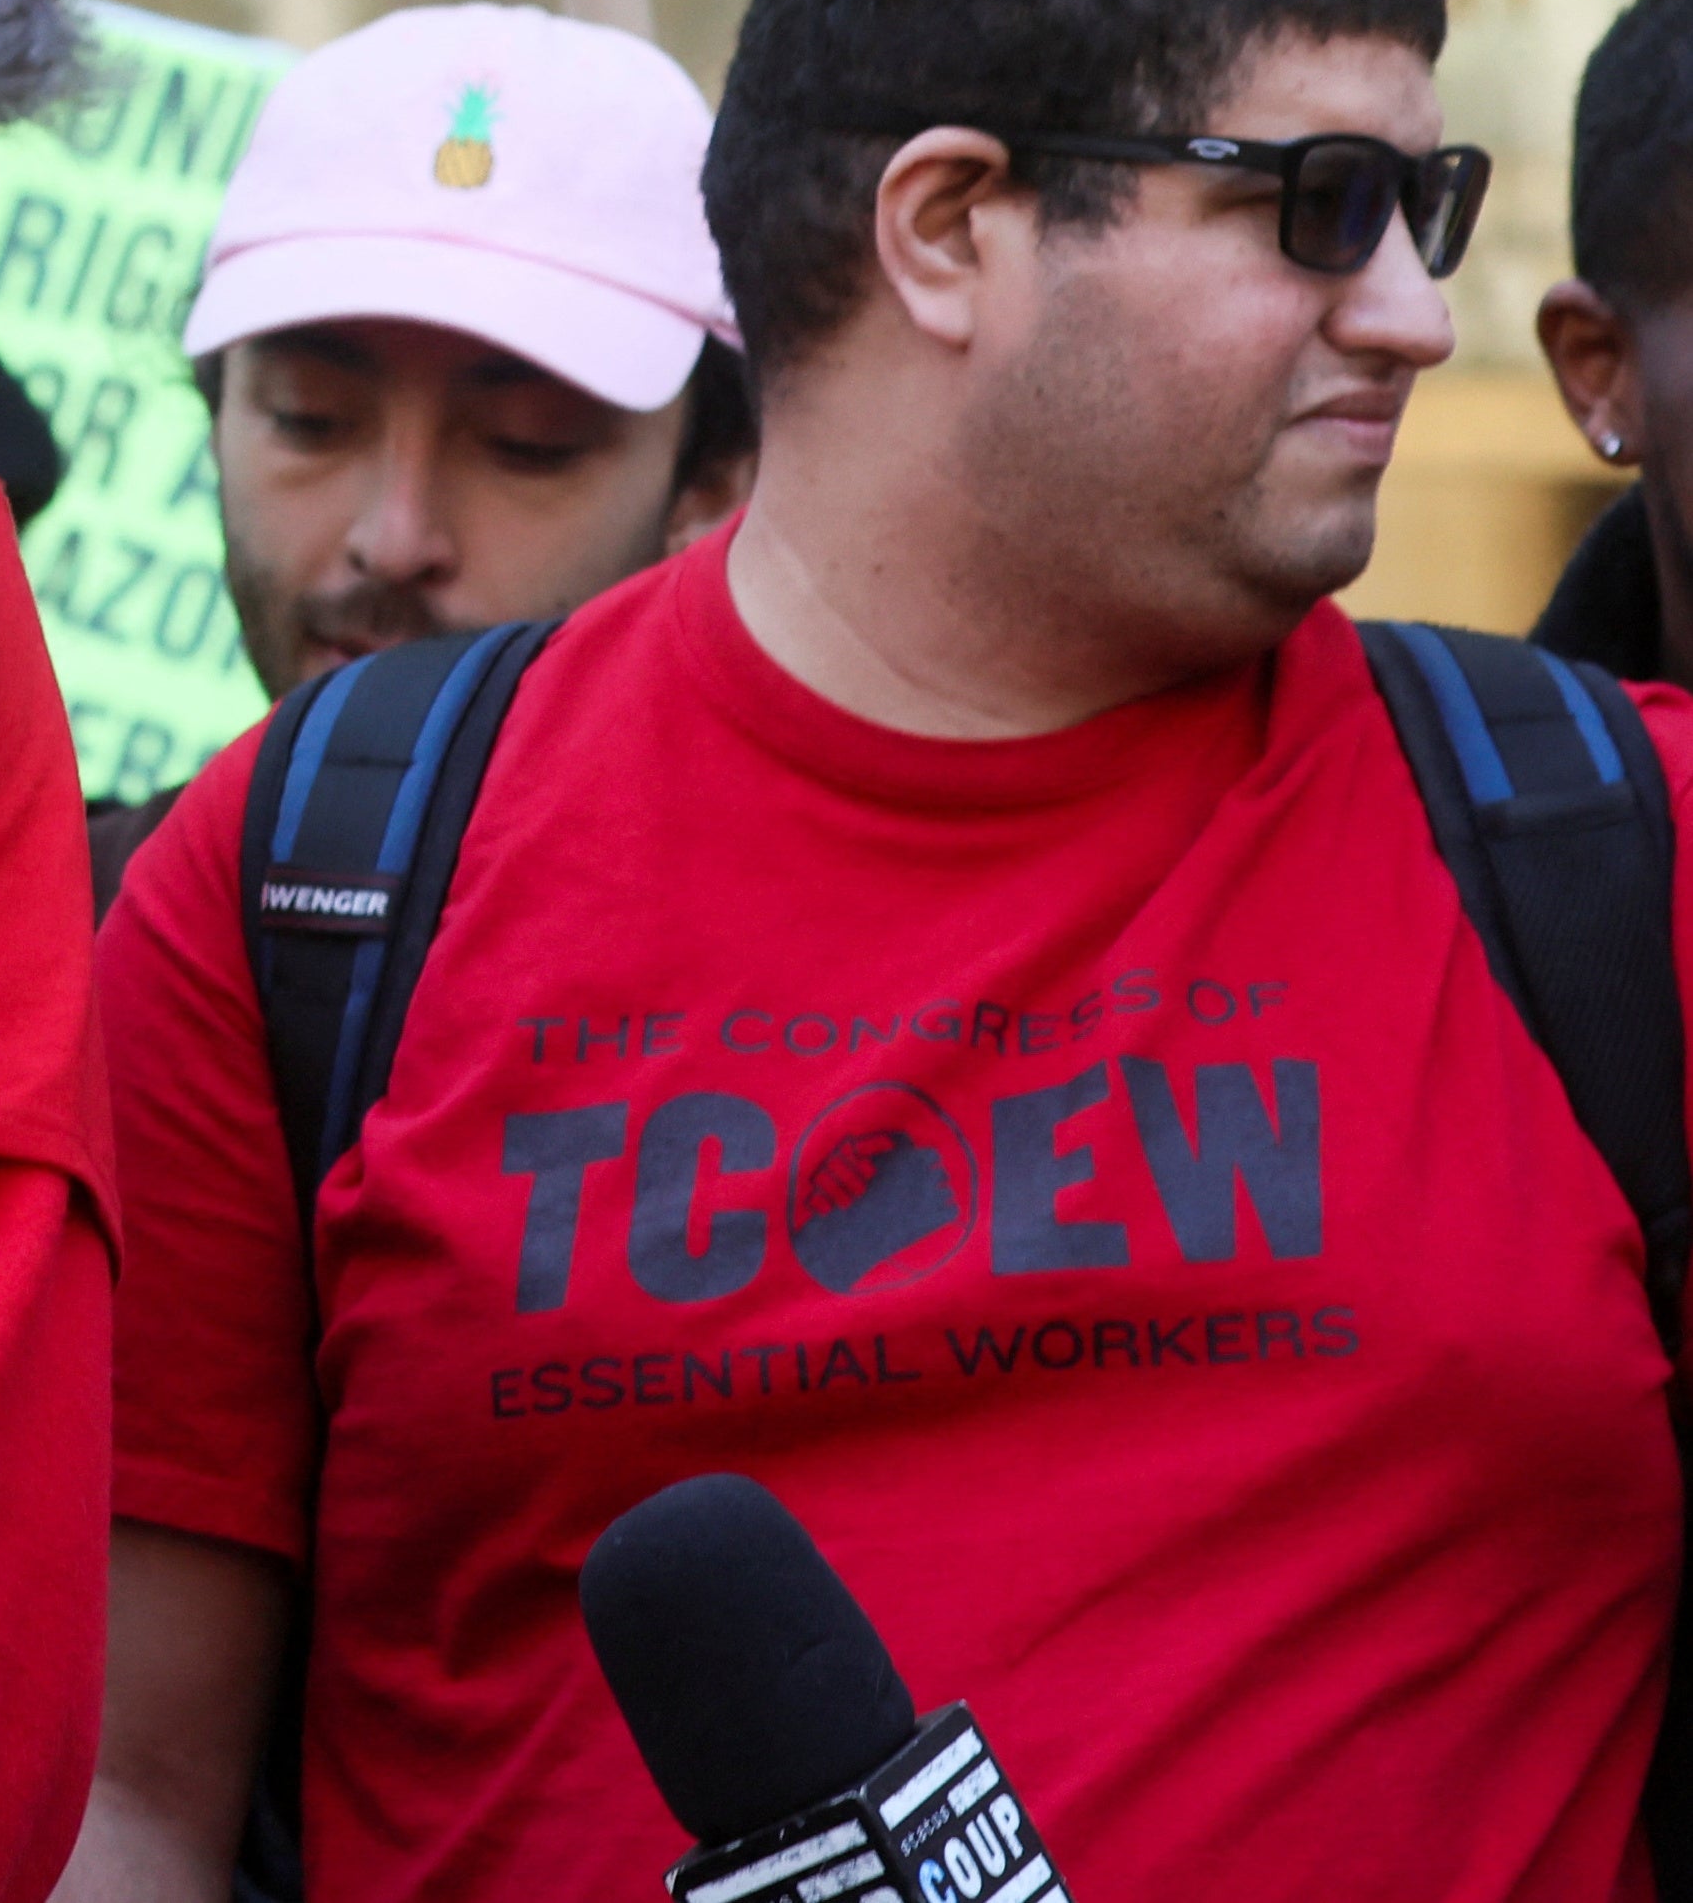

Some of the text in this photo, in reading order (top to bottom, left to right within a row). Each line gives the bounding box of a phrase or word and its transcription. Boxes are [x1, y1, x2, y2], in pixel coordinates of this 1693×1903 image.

[267, 883, 390, 918] WENGER
[517, 968, 1291, 1065] THE CONGRESS OF
[491, 1305, 1360, 1419] ESSENTIAL WORKERS
[918, 1791, 1024, 1903] COUP
